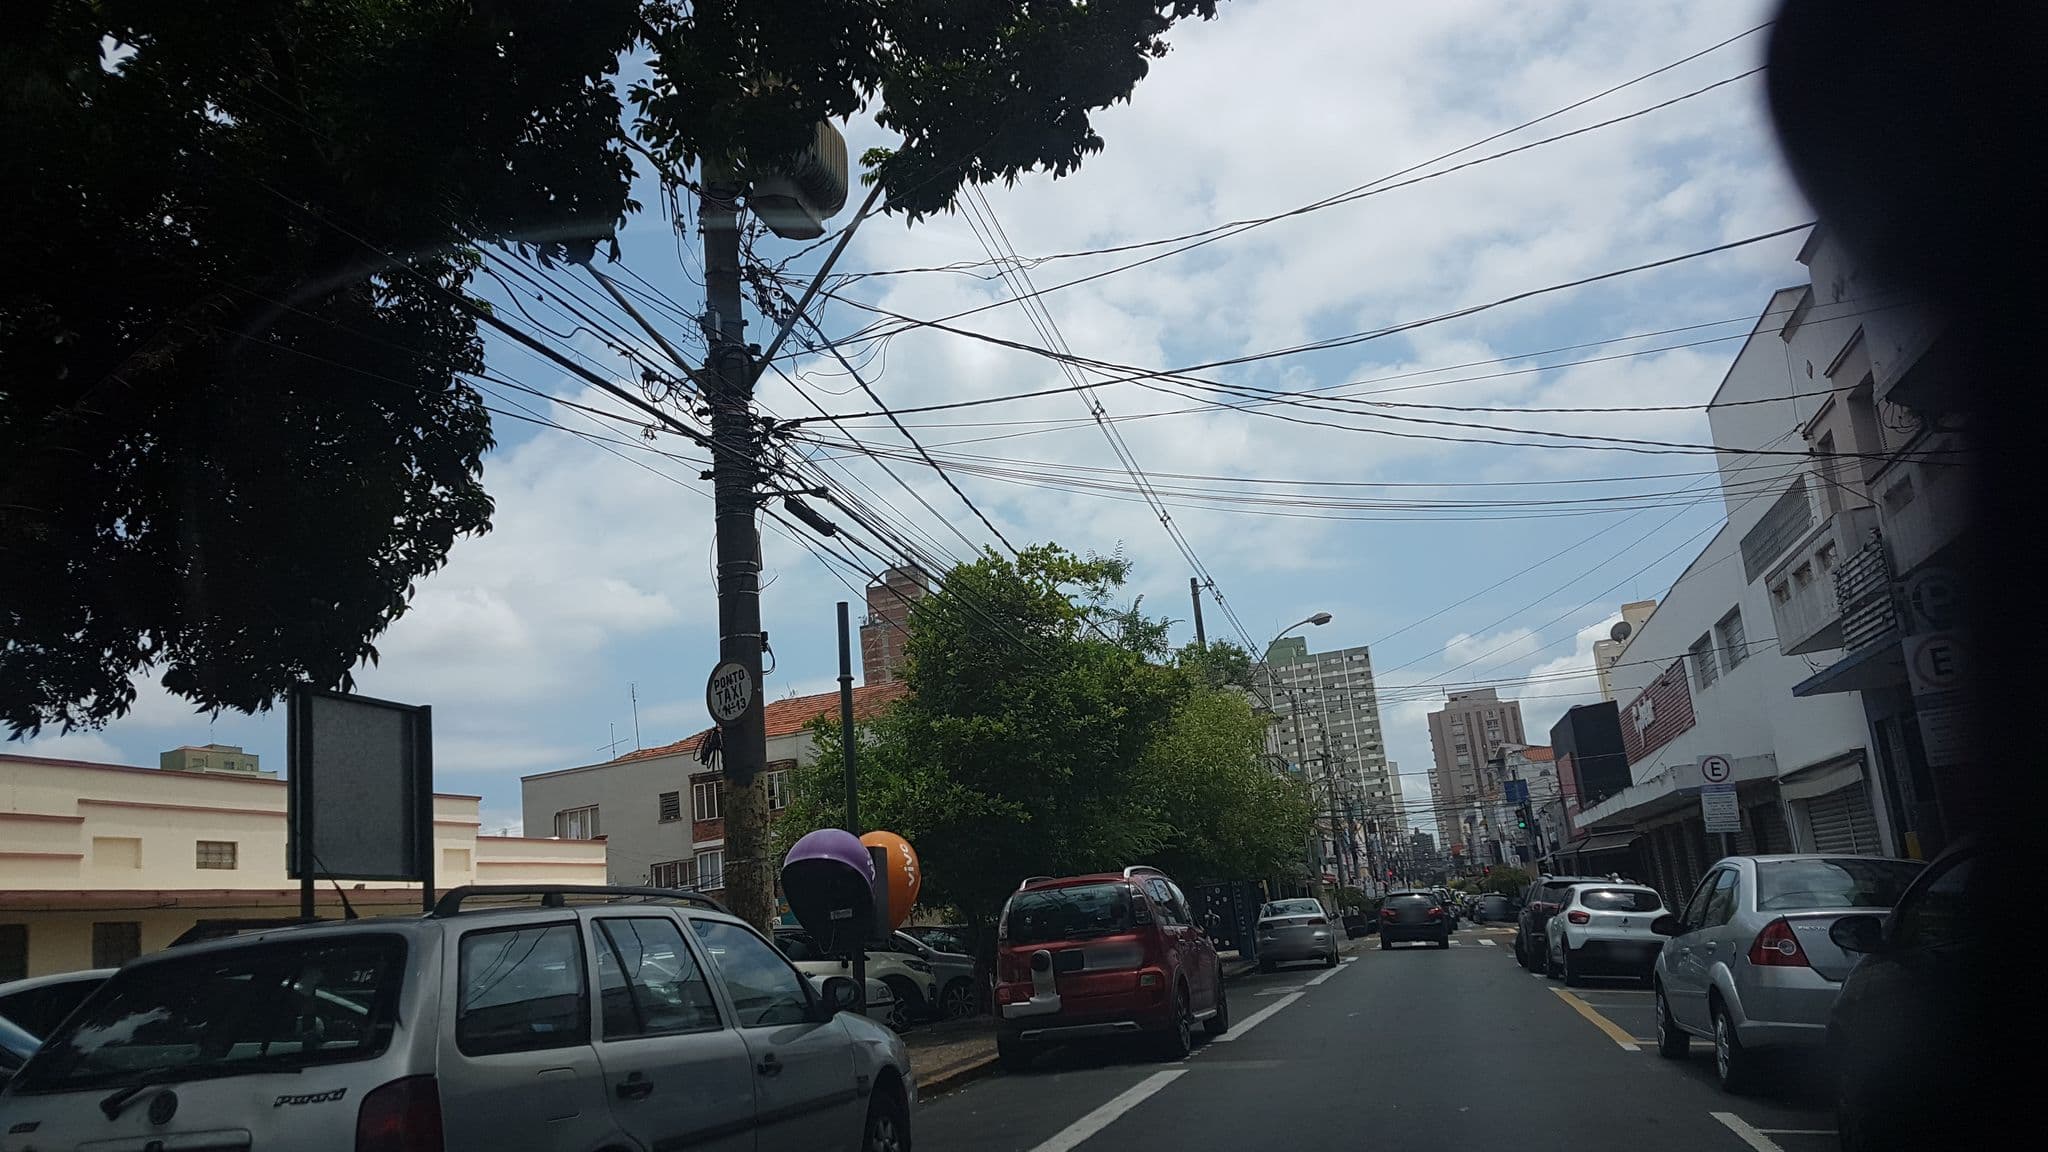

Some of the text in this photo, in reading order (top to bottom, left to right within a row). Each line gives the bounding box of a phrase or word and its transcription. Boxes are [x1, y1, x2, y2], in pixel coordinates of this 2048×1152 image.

[714, 669, 745, 691] PONTO
[716, 682, 743, 705] TAXI
[1710, 762, 1722, 776] E
[900, 843, 915, 887] vivo
